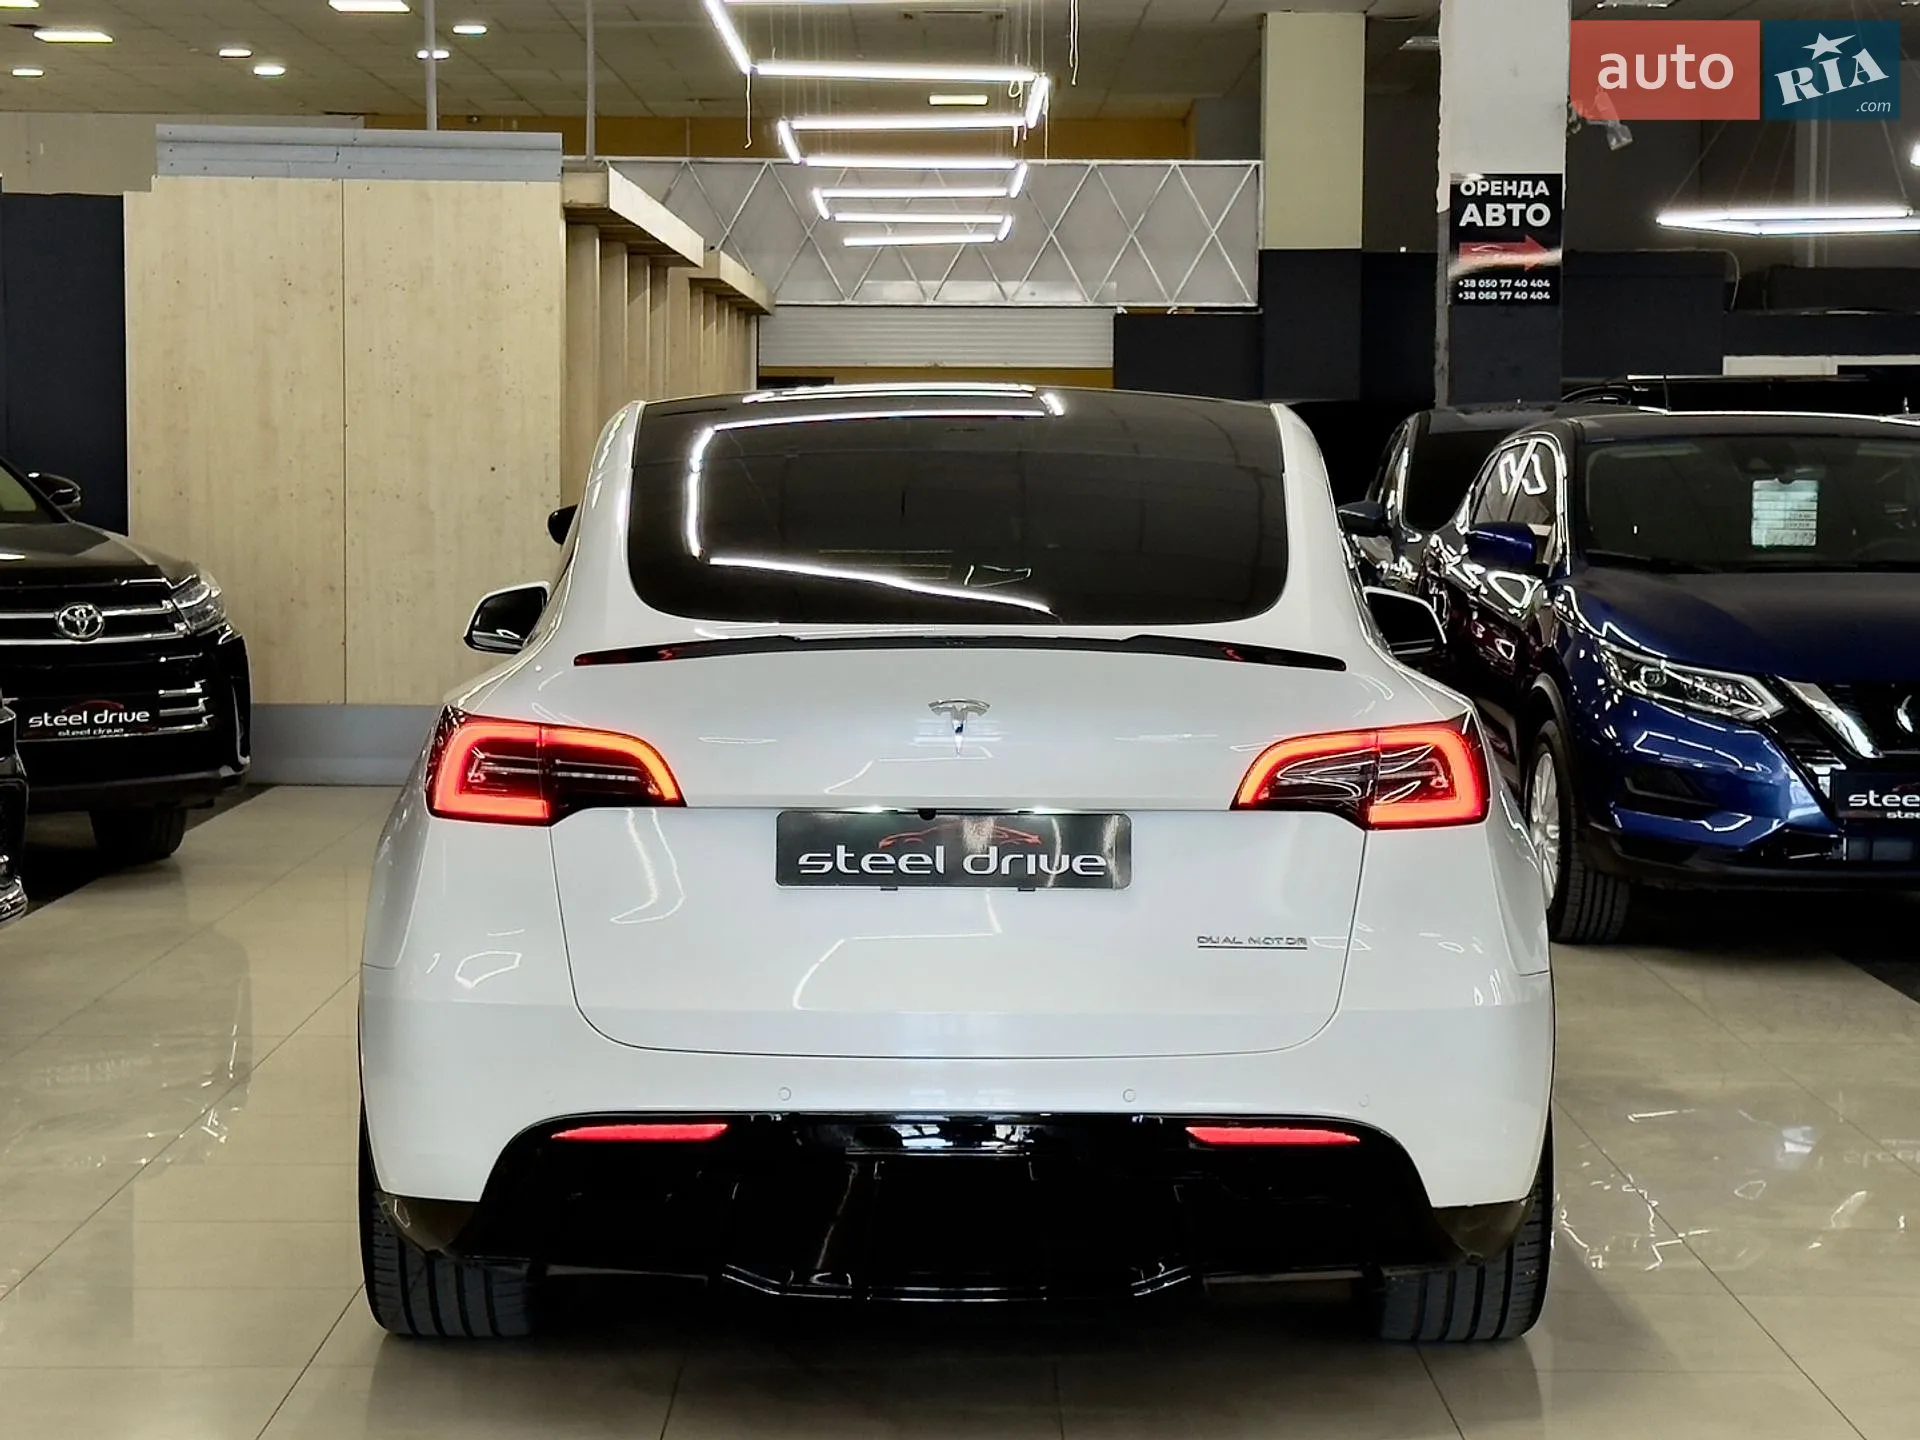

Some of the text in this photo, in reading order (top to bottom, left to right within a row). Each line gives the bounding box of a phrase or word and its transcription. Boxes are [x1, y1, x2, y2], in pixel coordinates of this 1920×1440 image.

[1460, 180, 1550, 198] ОРЕНДА
[1459, 203, 1551, 227] АВТО
[1458, 279, 1476, 288] +38
[1499, 279, 1513, 288] 77
[1514, 279, 1528, 288] 40
[1530, 279, 1550, 288] 404
[1458, 291, 1476, 300] +38
[1499, 291, 1513, 300] 77
[1514, 291, 1528, 300] 40
[1530, 291, 1550, 300] 404
[28, 709, 150, 728] steel drive
[798, 845, 1108, 876] steel drive
[1197, 935, 1244, 945] DUAL
